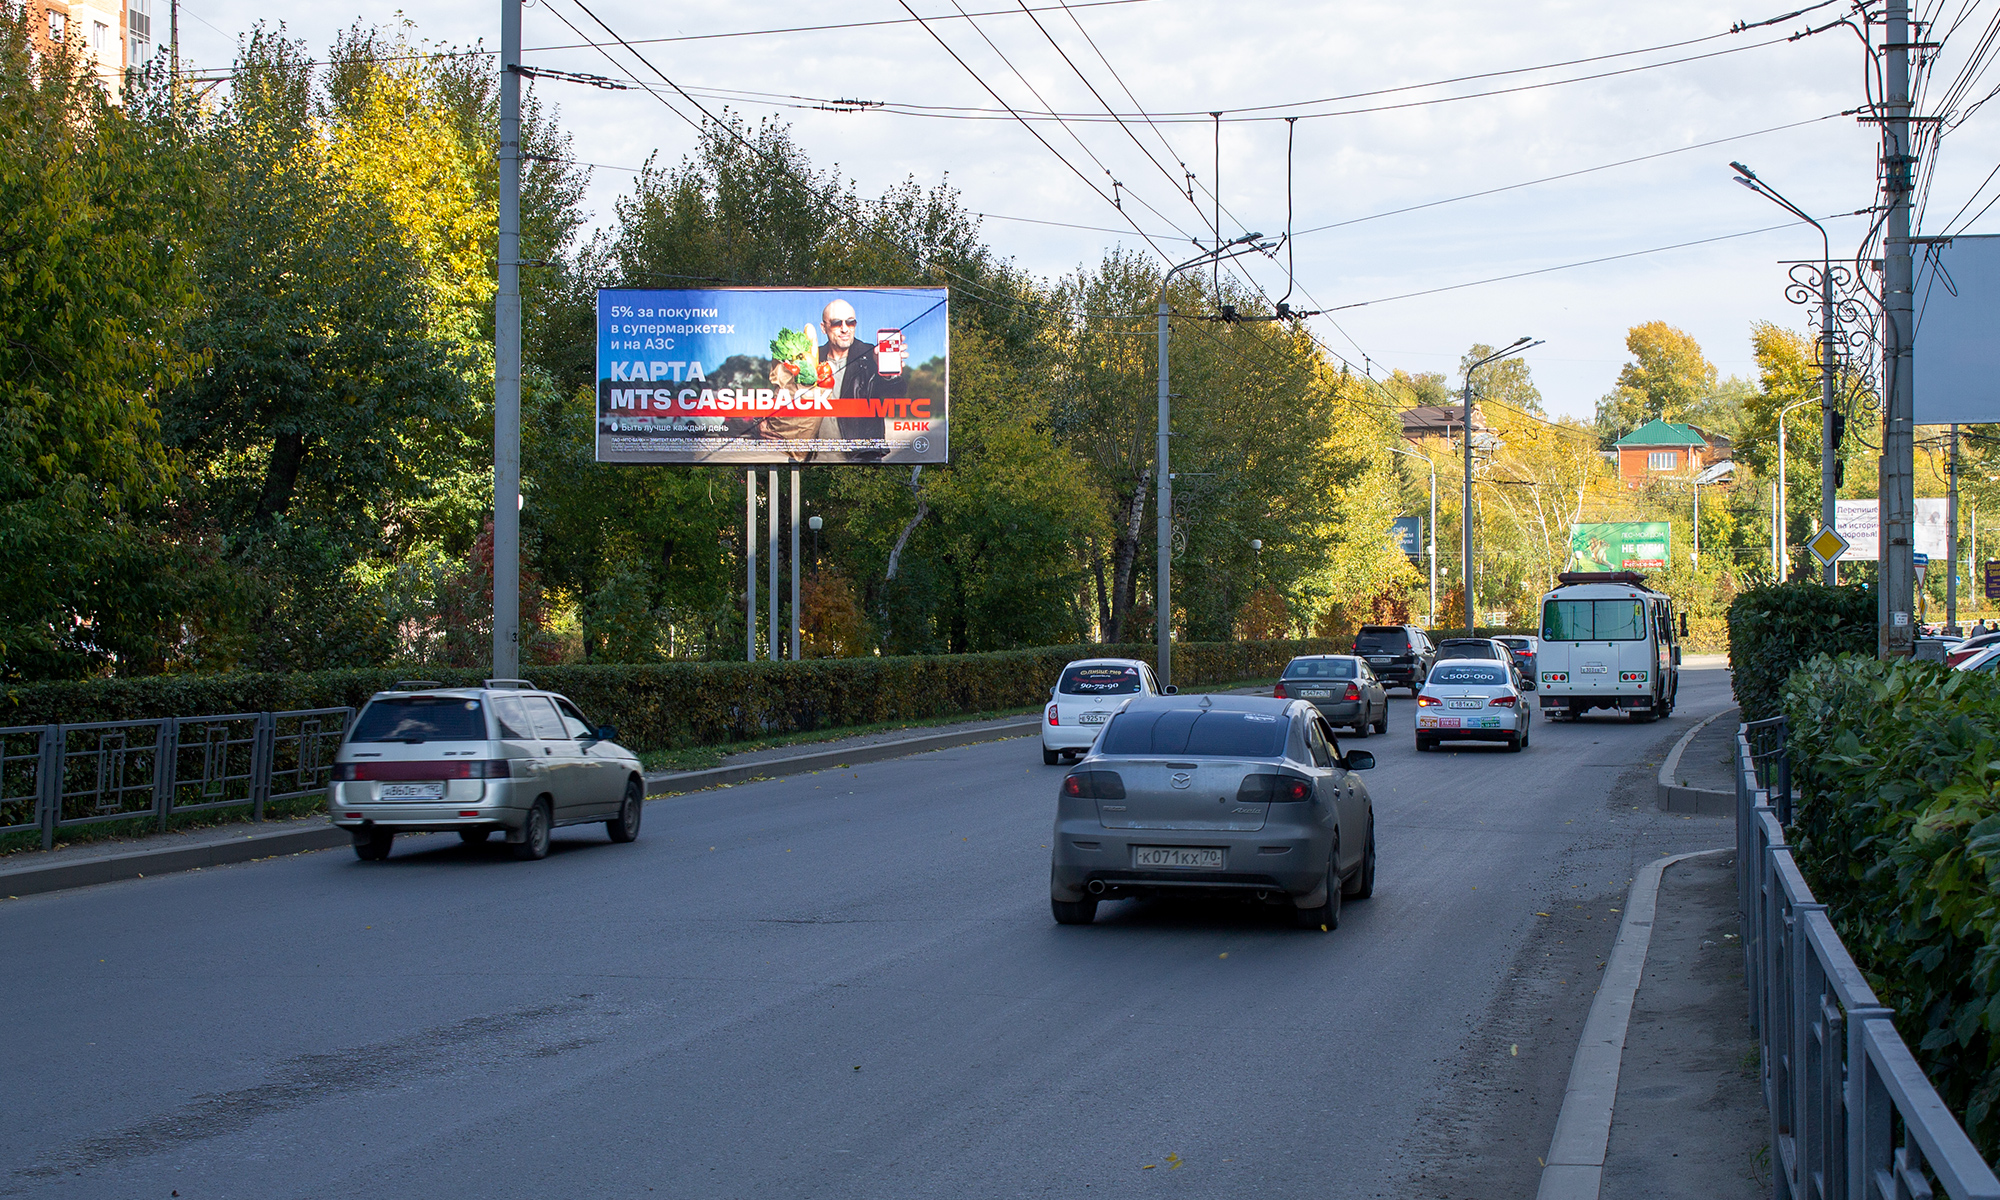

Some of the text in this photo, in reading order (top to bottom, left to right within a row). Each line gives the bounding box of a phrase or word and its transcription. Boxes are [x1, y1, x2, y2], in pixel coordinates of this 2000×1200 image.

[611, 306, 718, 320] 5% за покупки
[611, 324, 735, 336] в супермаркетах
[611, 338, 674, 350] и на АЗС
[611, 361, 706, 382] КАРТА
[610, 388, 832, 410] MTS CASHBACK
[644, 425, 670, 434] лучше
[673, 424, 706, 433] каждый
[708, 425, 728, 433] день
[894, 422, 930, 431] БАНК
[914, 440, 928, 449] 6+
[1622, 544, 1664, 552] НЕ ГУБИ!
[1142, 850, 1217, 864] К071КХ 70
